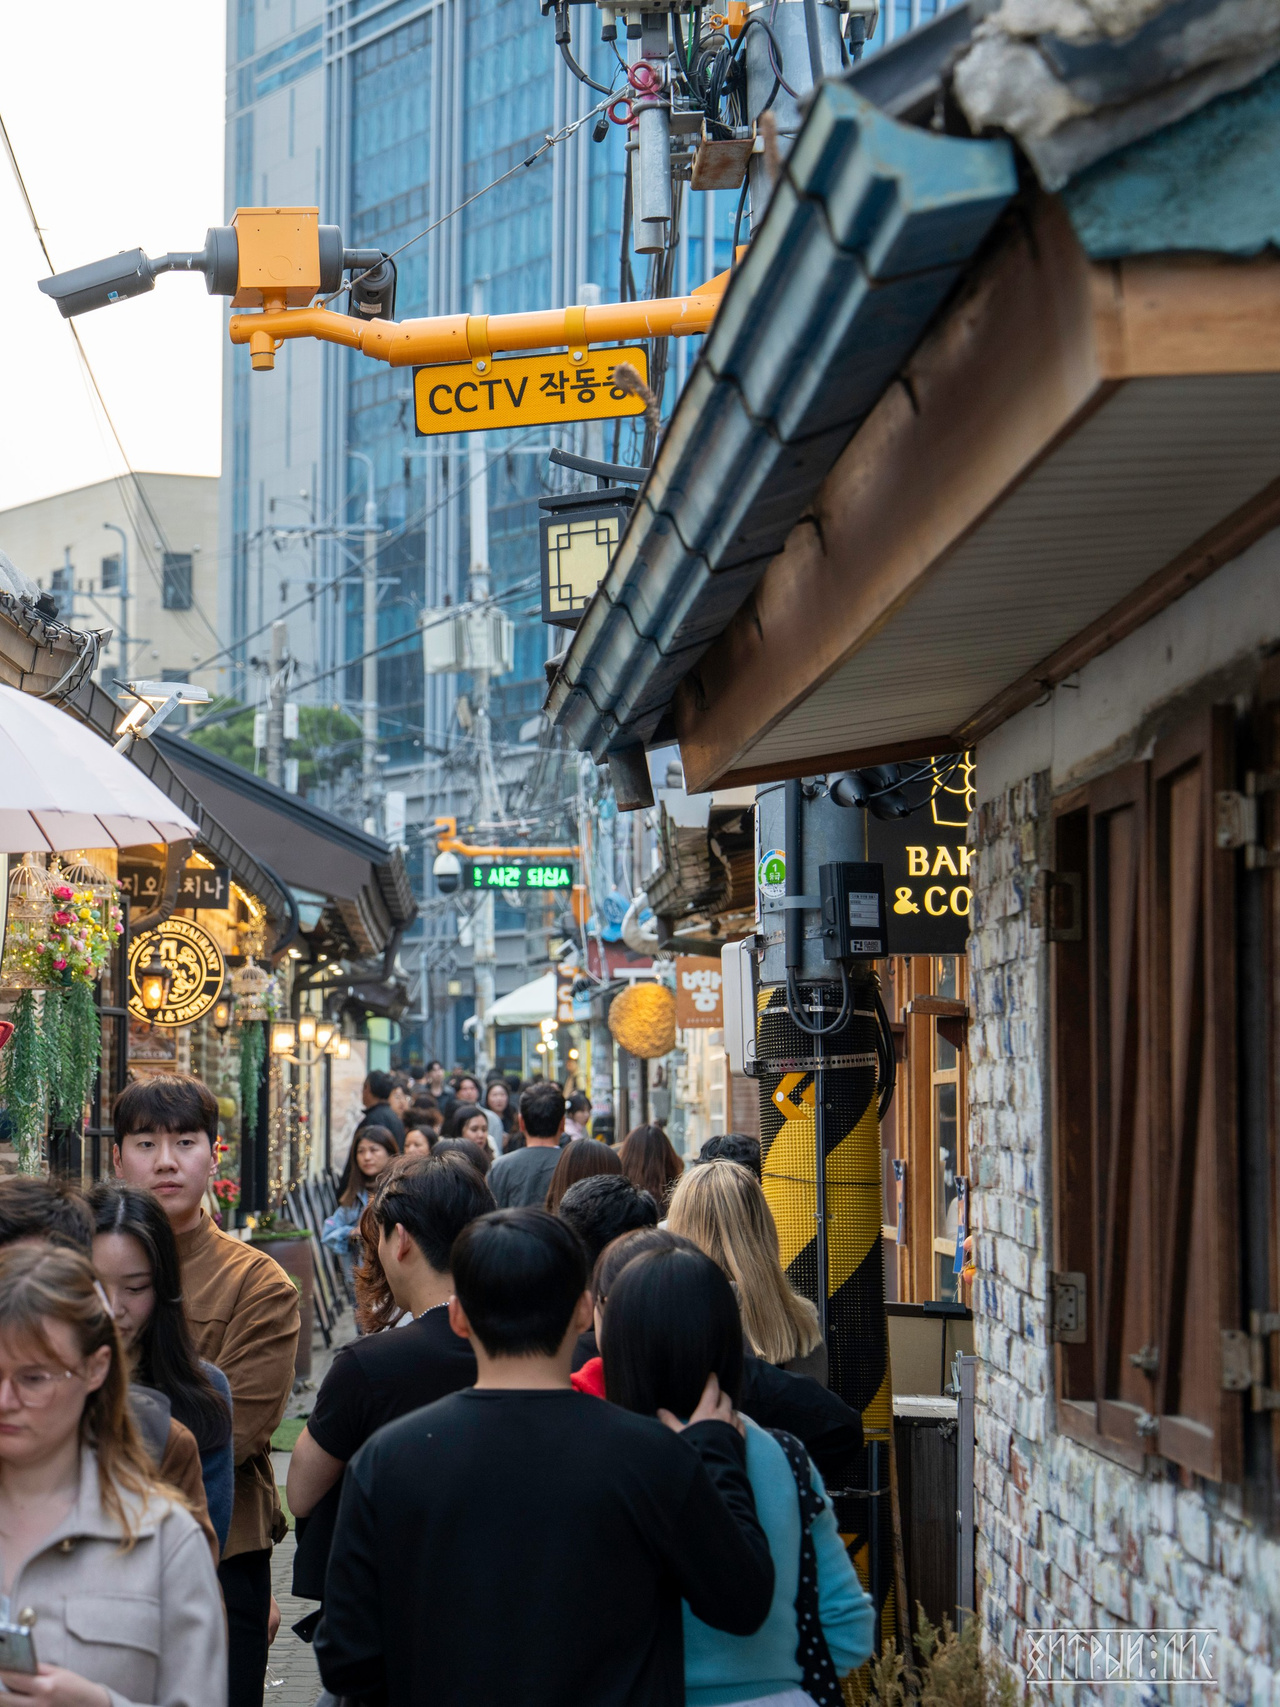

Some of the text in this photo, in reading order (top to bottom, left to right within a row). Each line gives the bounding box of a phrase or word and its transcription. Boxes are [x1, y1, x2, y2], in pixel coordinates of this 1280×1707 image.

[428, 376, 529, 415] CCTV
[121, 873, 225, 900] 지오치나
[488, 866, 522, 887] 시간
[157, 920, 220, 971] RESTAURANT
[175, 993, 213, 1021] PASTA
[682, 970, 722, 1012] 빵
